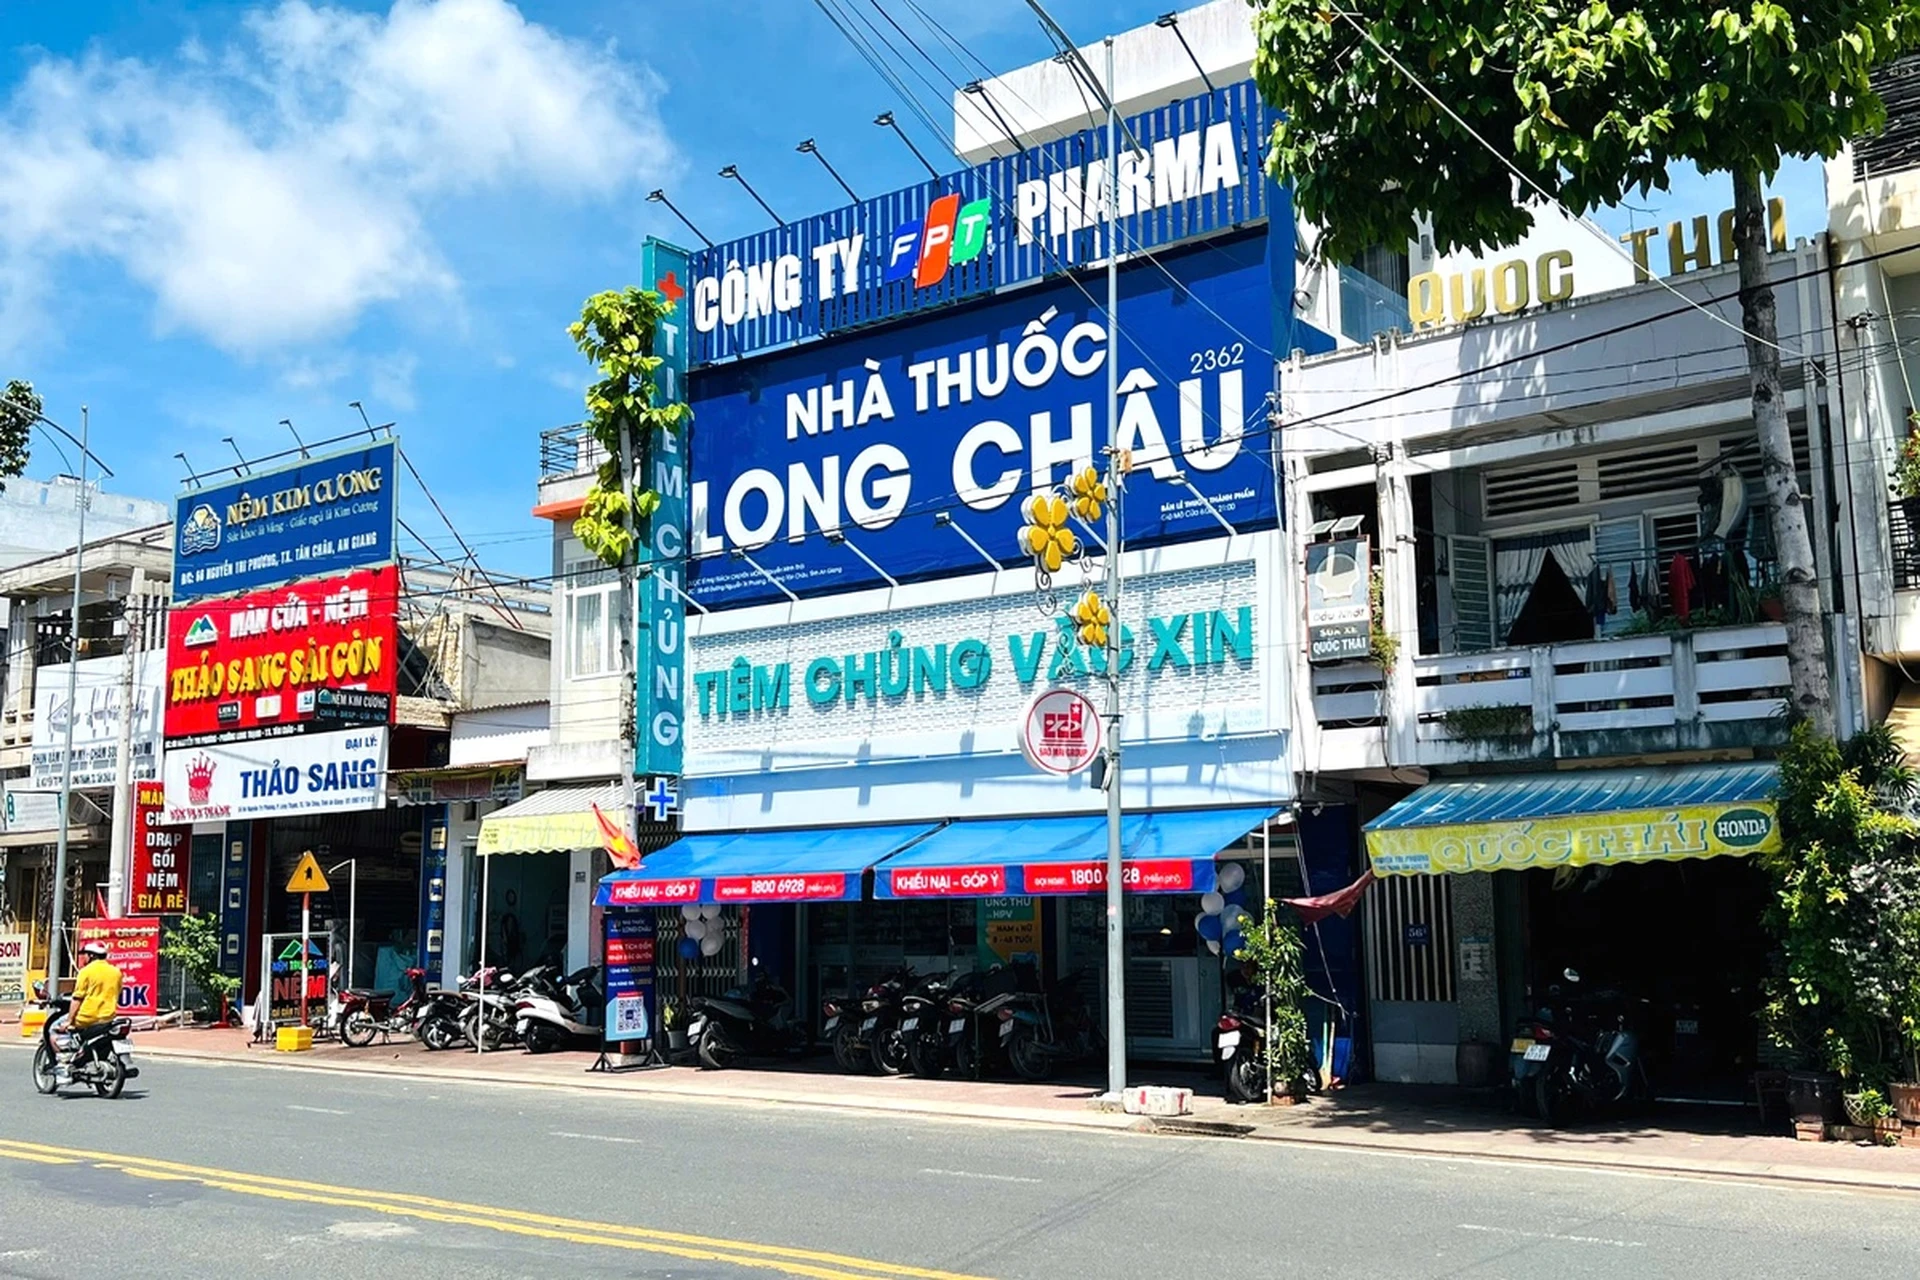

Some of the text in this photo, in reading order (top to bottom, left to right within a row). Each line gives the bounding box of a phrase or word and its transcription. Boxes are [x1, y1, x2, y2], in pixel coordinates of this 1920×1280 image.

[694, 121, 1240, 332] CÔNG TY FPT PHARMA
[1190, 343, 1245, 374] 2362
[786, 305, 1108, 440] NHÀ THUỐC
[691, 367, 1245, 559] LONG CHÂU
[226, 467, 382, 529] NỆM KIM CƯƠNG
[334, 507, 350, 519] Kim
[206, 559, 234, 580] NGUYỄN
[295, 544, 308, 560] TÂN
[337, 538, 350, 552] AN
[351, 532, 378, 549] GIANG
[229, 586, 368, 639] MÀN CỬA NỆM
[652, 523, 681, 747] CHỦNG
[1313, 635, 1367, 655] QUỐC THÁI
[171, 629, 383, 702] THẢO SANG SÀI GÒN
[694, 654, 790, 715] TIÊM
[804, 630, 991, 703] CHỦNG
[1147, 605, 1253, 671] XIN
[348, 695, 363, 705] KIM
[345, 737, 363, 752] ĐẠI
[1066, 747, 1087, 757] GROUP
[240, 759, 299, 798] THẢO
[308, 758, 376, 792] SANG
[146, 832, 182, 847] DRAP
[1433, 821, 1573, 871] QUỐC
[1579, 813, 1707, 858] THÁI
[1718, 818, 1767, 838] HONDA
[152, 848, 175, 868] GỐI
[146, 869, 178, 890] NỆM
[751, 879, 776, 894] 1800
[777, 878, 806, 893] 6928
[897, 870, 999, 893] KHIẾU NẠI GÓP Ý
[1070, 869, 1103, 884] 1800
[1106, 868, 1140, 884] 28
[137, 889, 184, 909] GIÁ RẺ
[615, 880, 697, 901] KHIẾU NẠI GÓP Ý
[993, 910, 1013, 918] HPV
[273, 971, 327, 1005] NỆM
